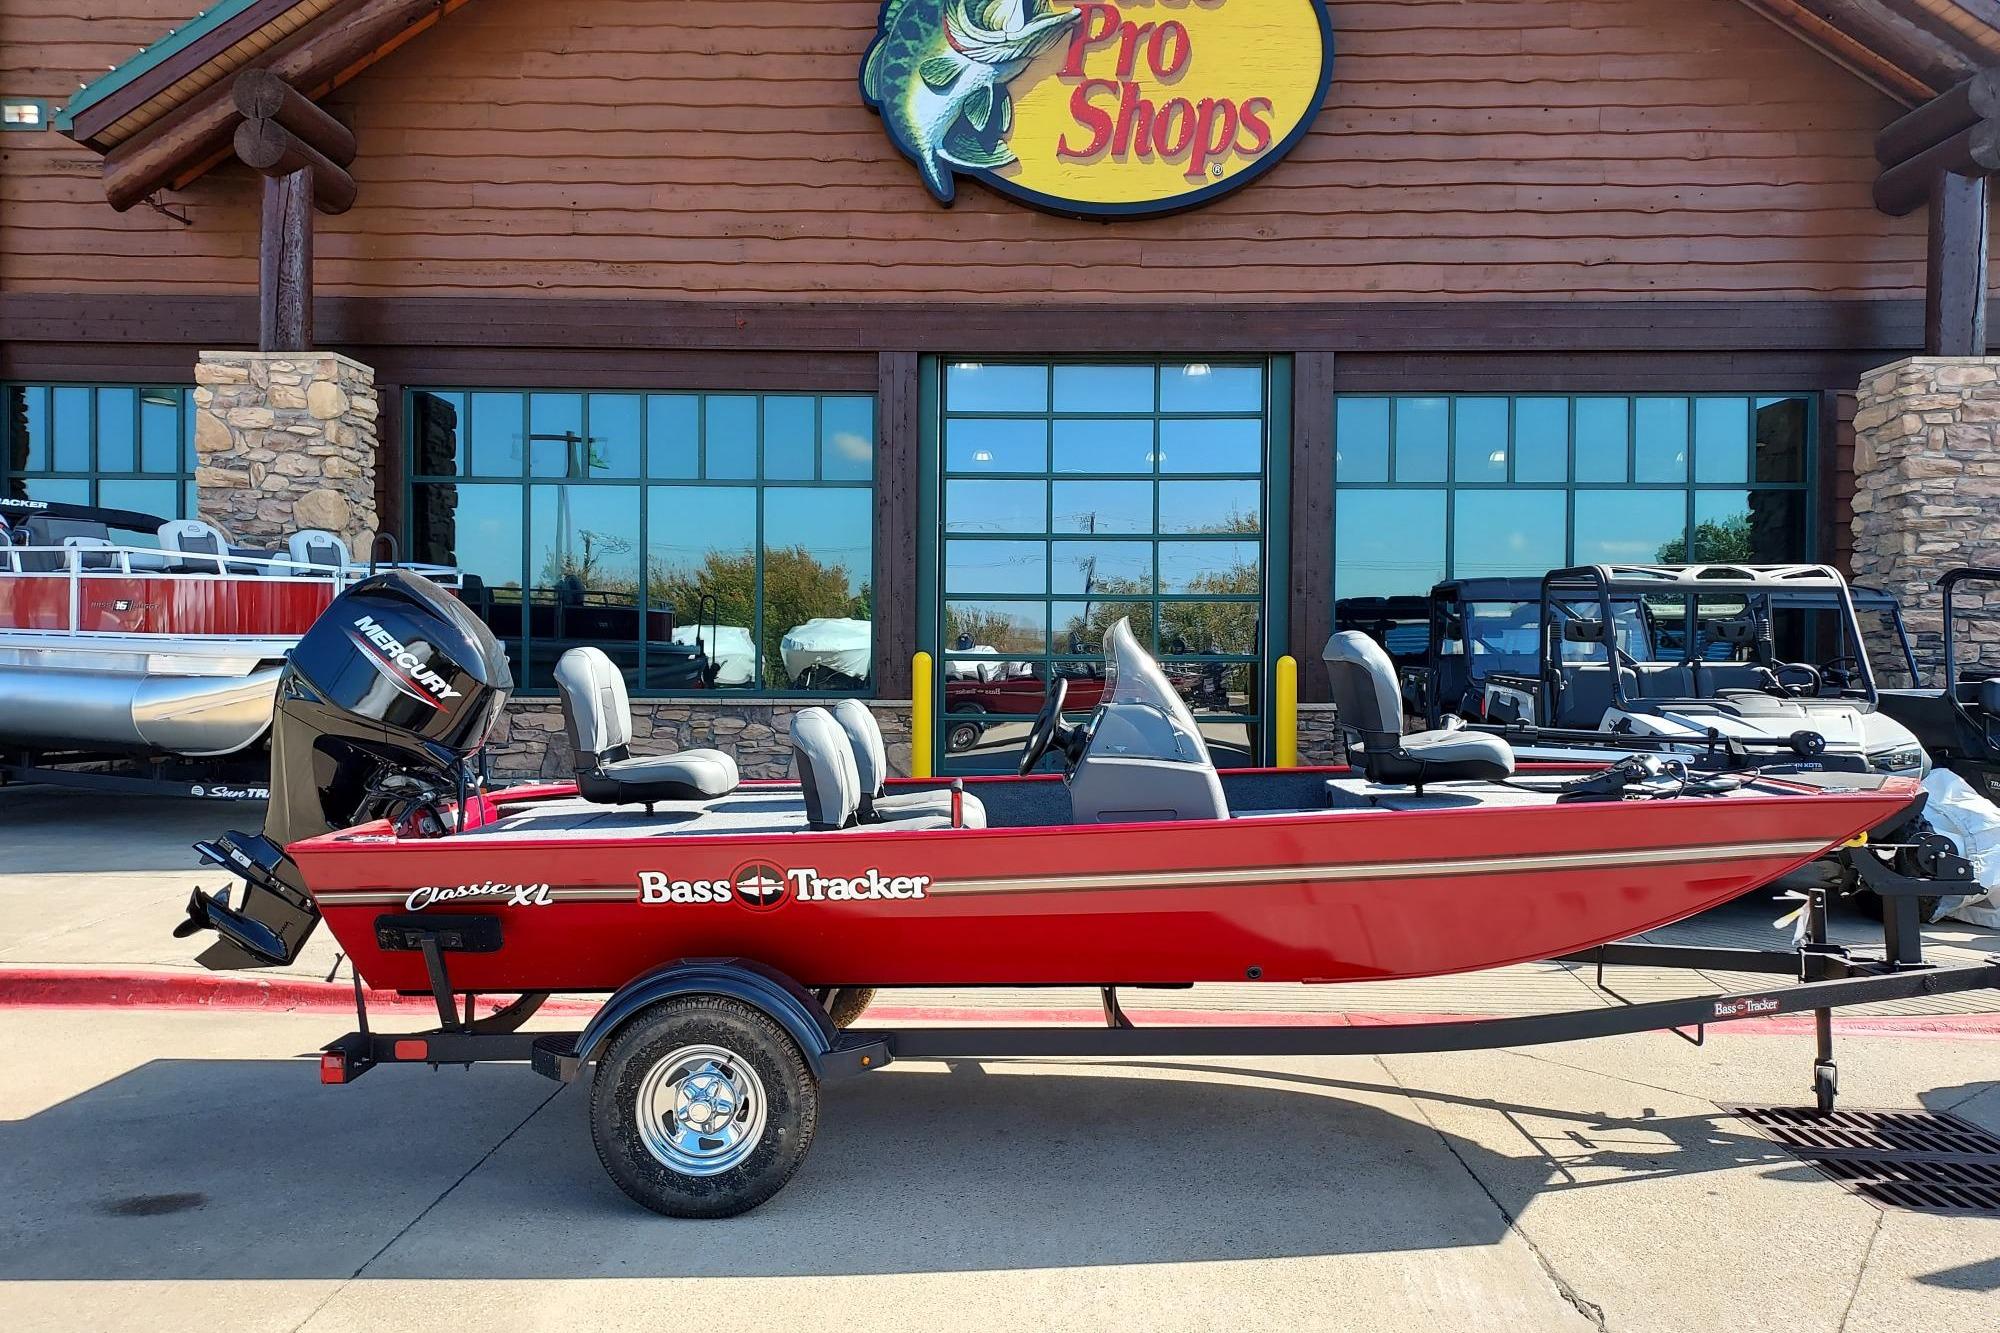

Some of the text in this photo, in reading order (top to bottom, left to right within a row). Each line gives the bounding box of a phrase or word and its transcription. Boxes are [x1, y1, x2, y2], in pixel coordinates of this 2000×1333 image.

[1056, 3, 1191, 78] Pro
[1056, 78, 1273, 177] Shops
[0, 498, 48, 508] ACKER
[353, 615, 462, 699] MERCURY
[405, 881, 553, 911] Classic XL
[638, 868, 930, 903] Bass Tracker
[1714, 1000, 1778, 1015] Bass Tracker
